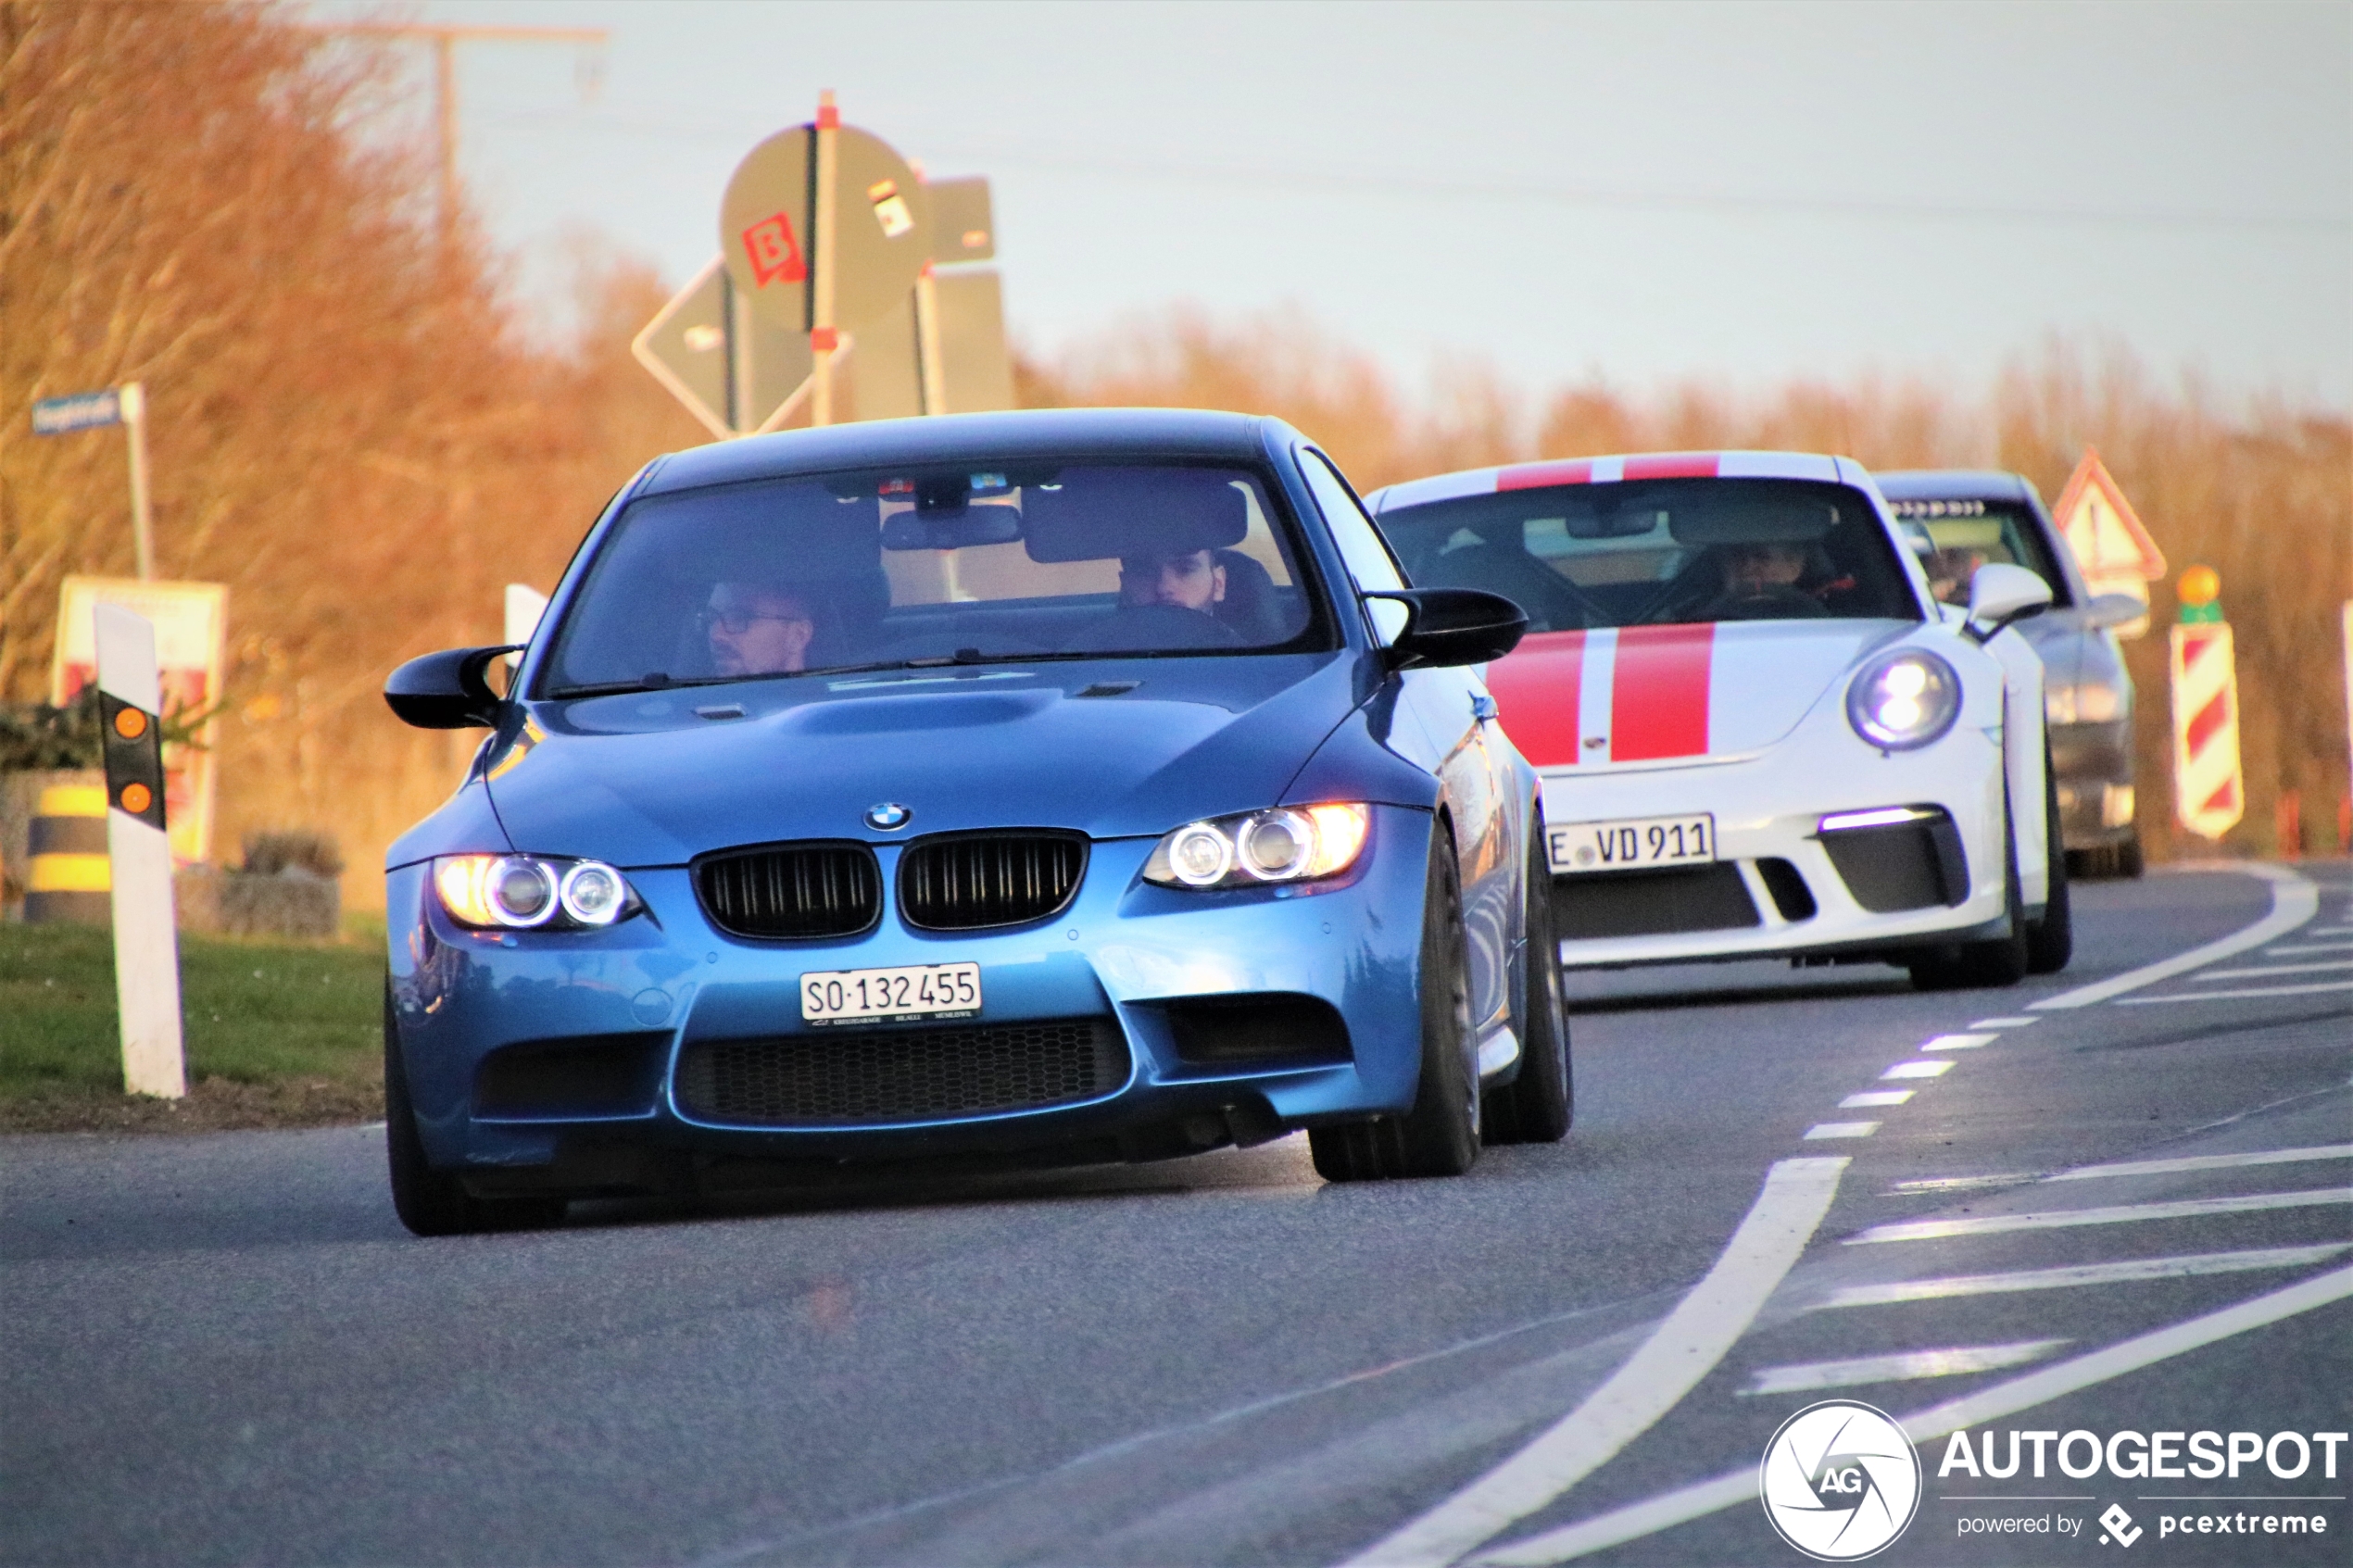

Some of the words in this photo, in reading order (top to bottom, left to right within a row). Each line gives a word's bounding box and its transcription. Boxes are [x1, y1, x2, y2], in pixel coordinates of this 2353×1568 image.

[1550, 834, 1569, 865] E
[1597, 827, 1638, 862] VD
[1648, 822, 1708, 860] 911
